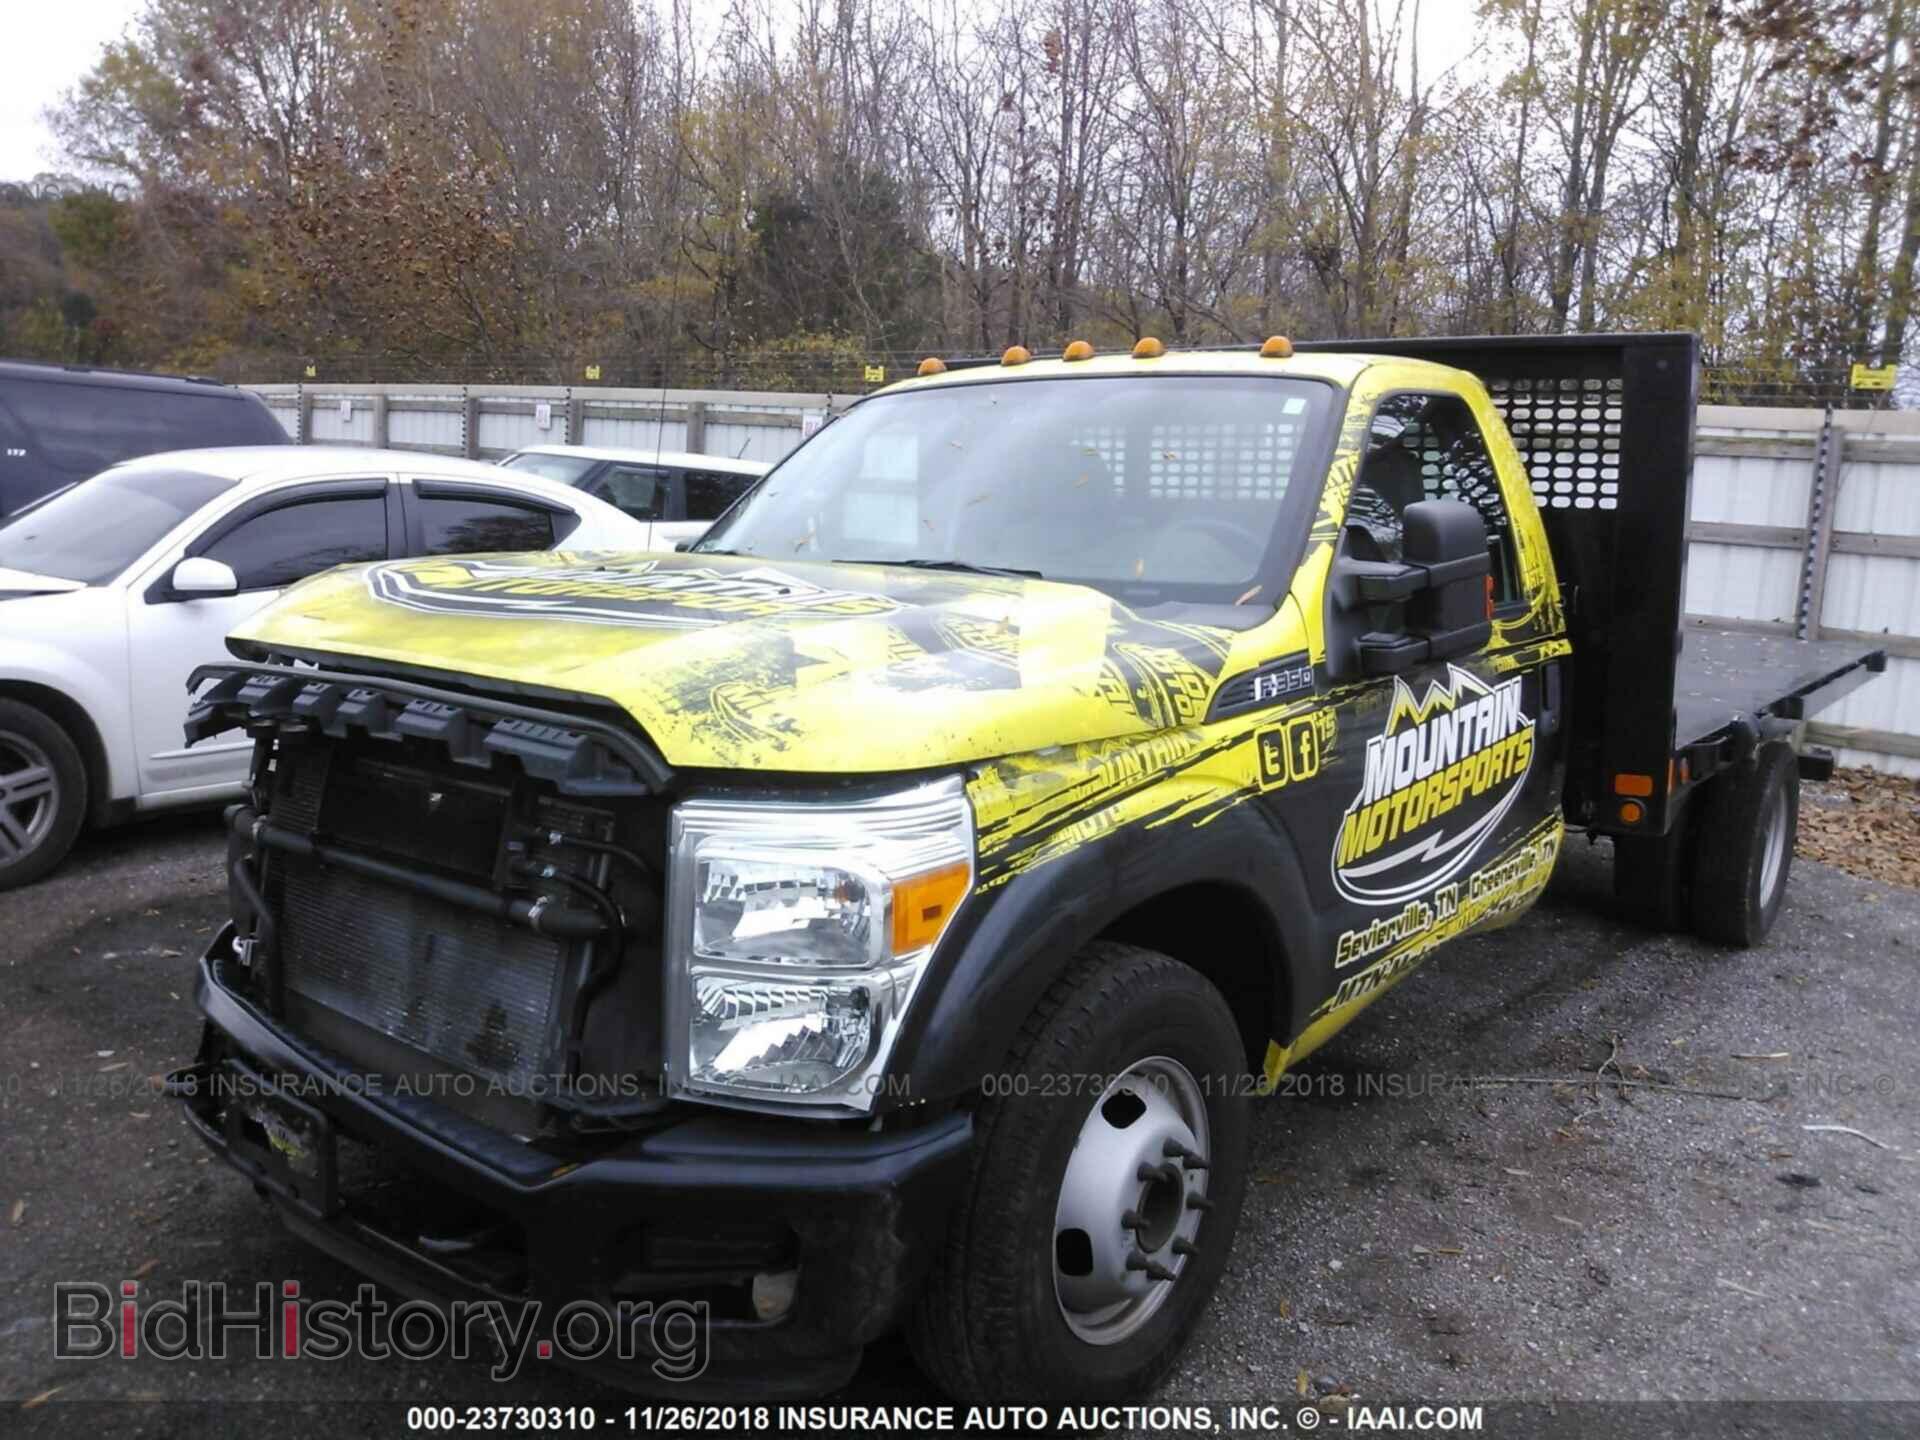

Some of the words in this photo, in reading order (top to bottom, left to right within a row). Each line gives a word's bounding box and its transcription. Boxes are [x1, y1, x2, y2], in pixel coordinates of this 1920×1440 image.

[1336, 722, 1535, 868] MOTORSPORTS
[1363, 680, 1521, 806] MOUNTAIN
[1335, 900, 1433, 968] Sevierville,
[1435, 882, 1458, 921] TN
